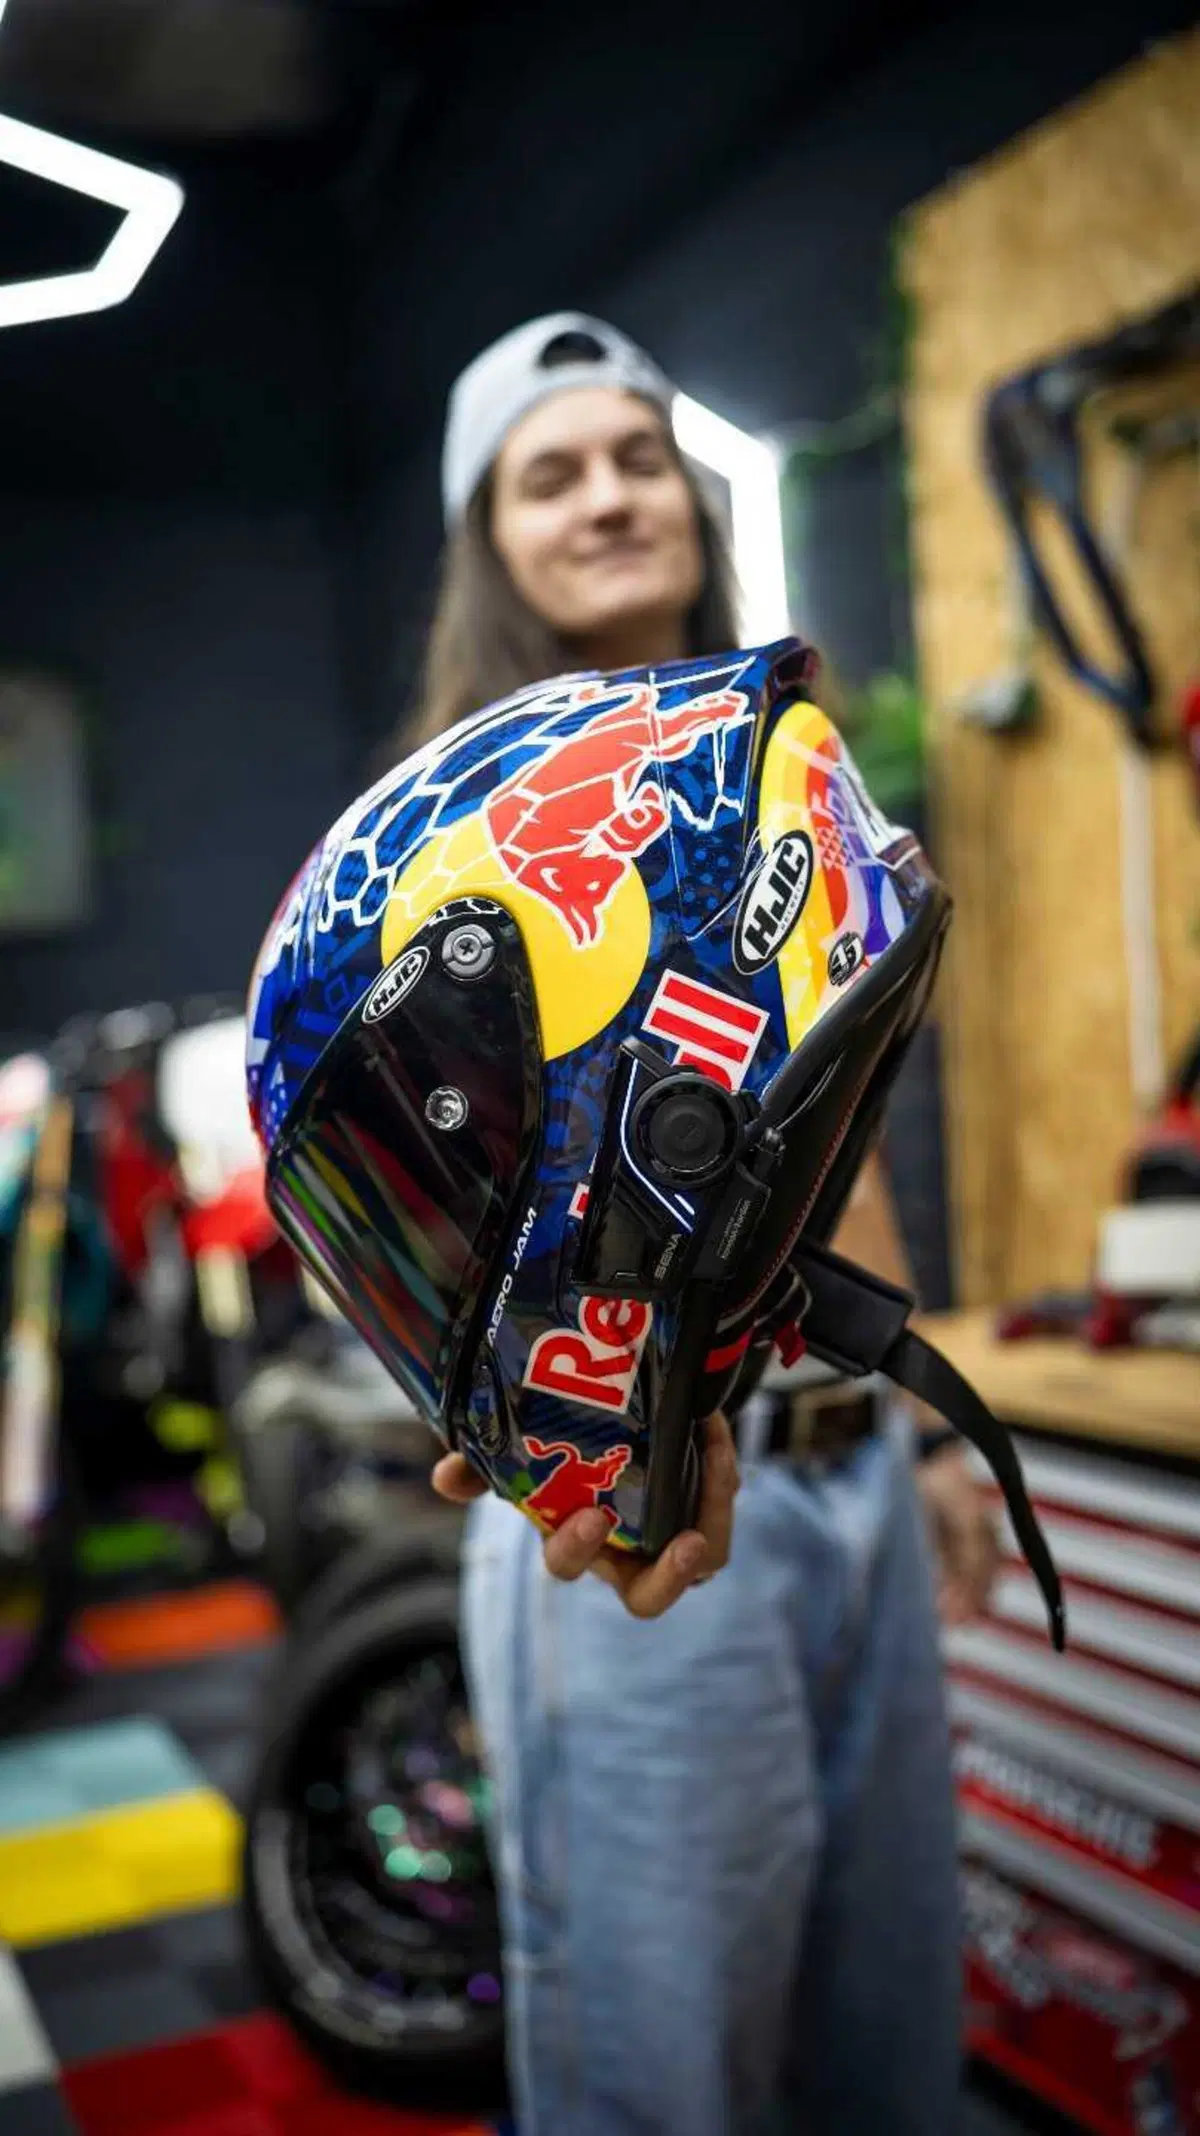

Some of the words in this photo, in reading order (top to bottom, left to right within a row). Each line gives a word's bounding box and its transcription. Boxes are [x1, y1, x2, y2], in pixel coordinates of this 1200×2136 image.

[744, 841, 806, 958] HJC
[371, 955, 420, 1016] HJC
[487, 1273, 513, 1348] AERO
[513, 1207, 538, 1271] JAM
[654, 1232, 682, 1280] SENA
[525, 1297, 651, 1412] Re
